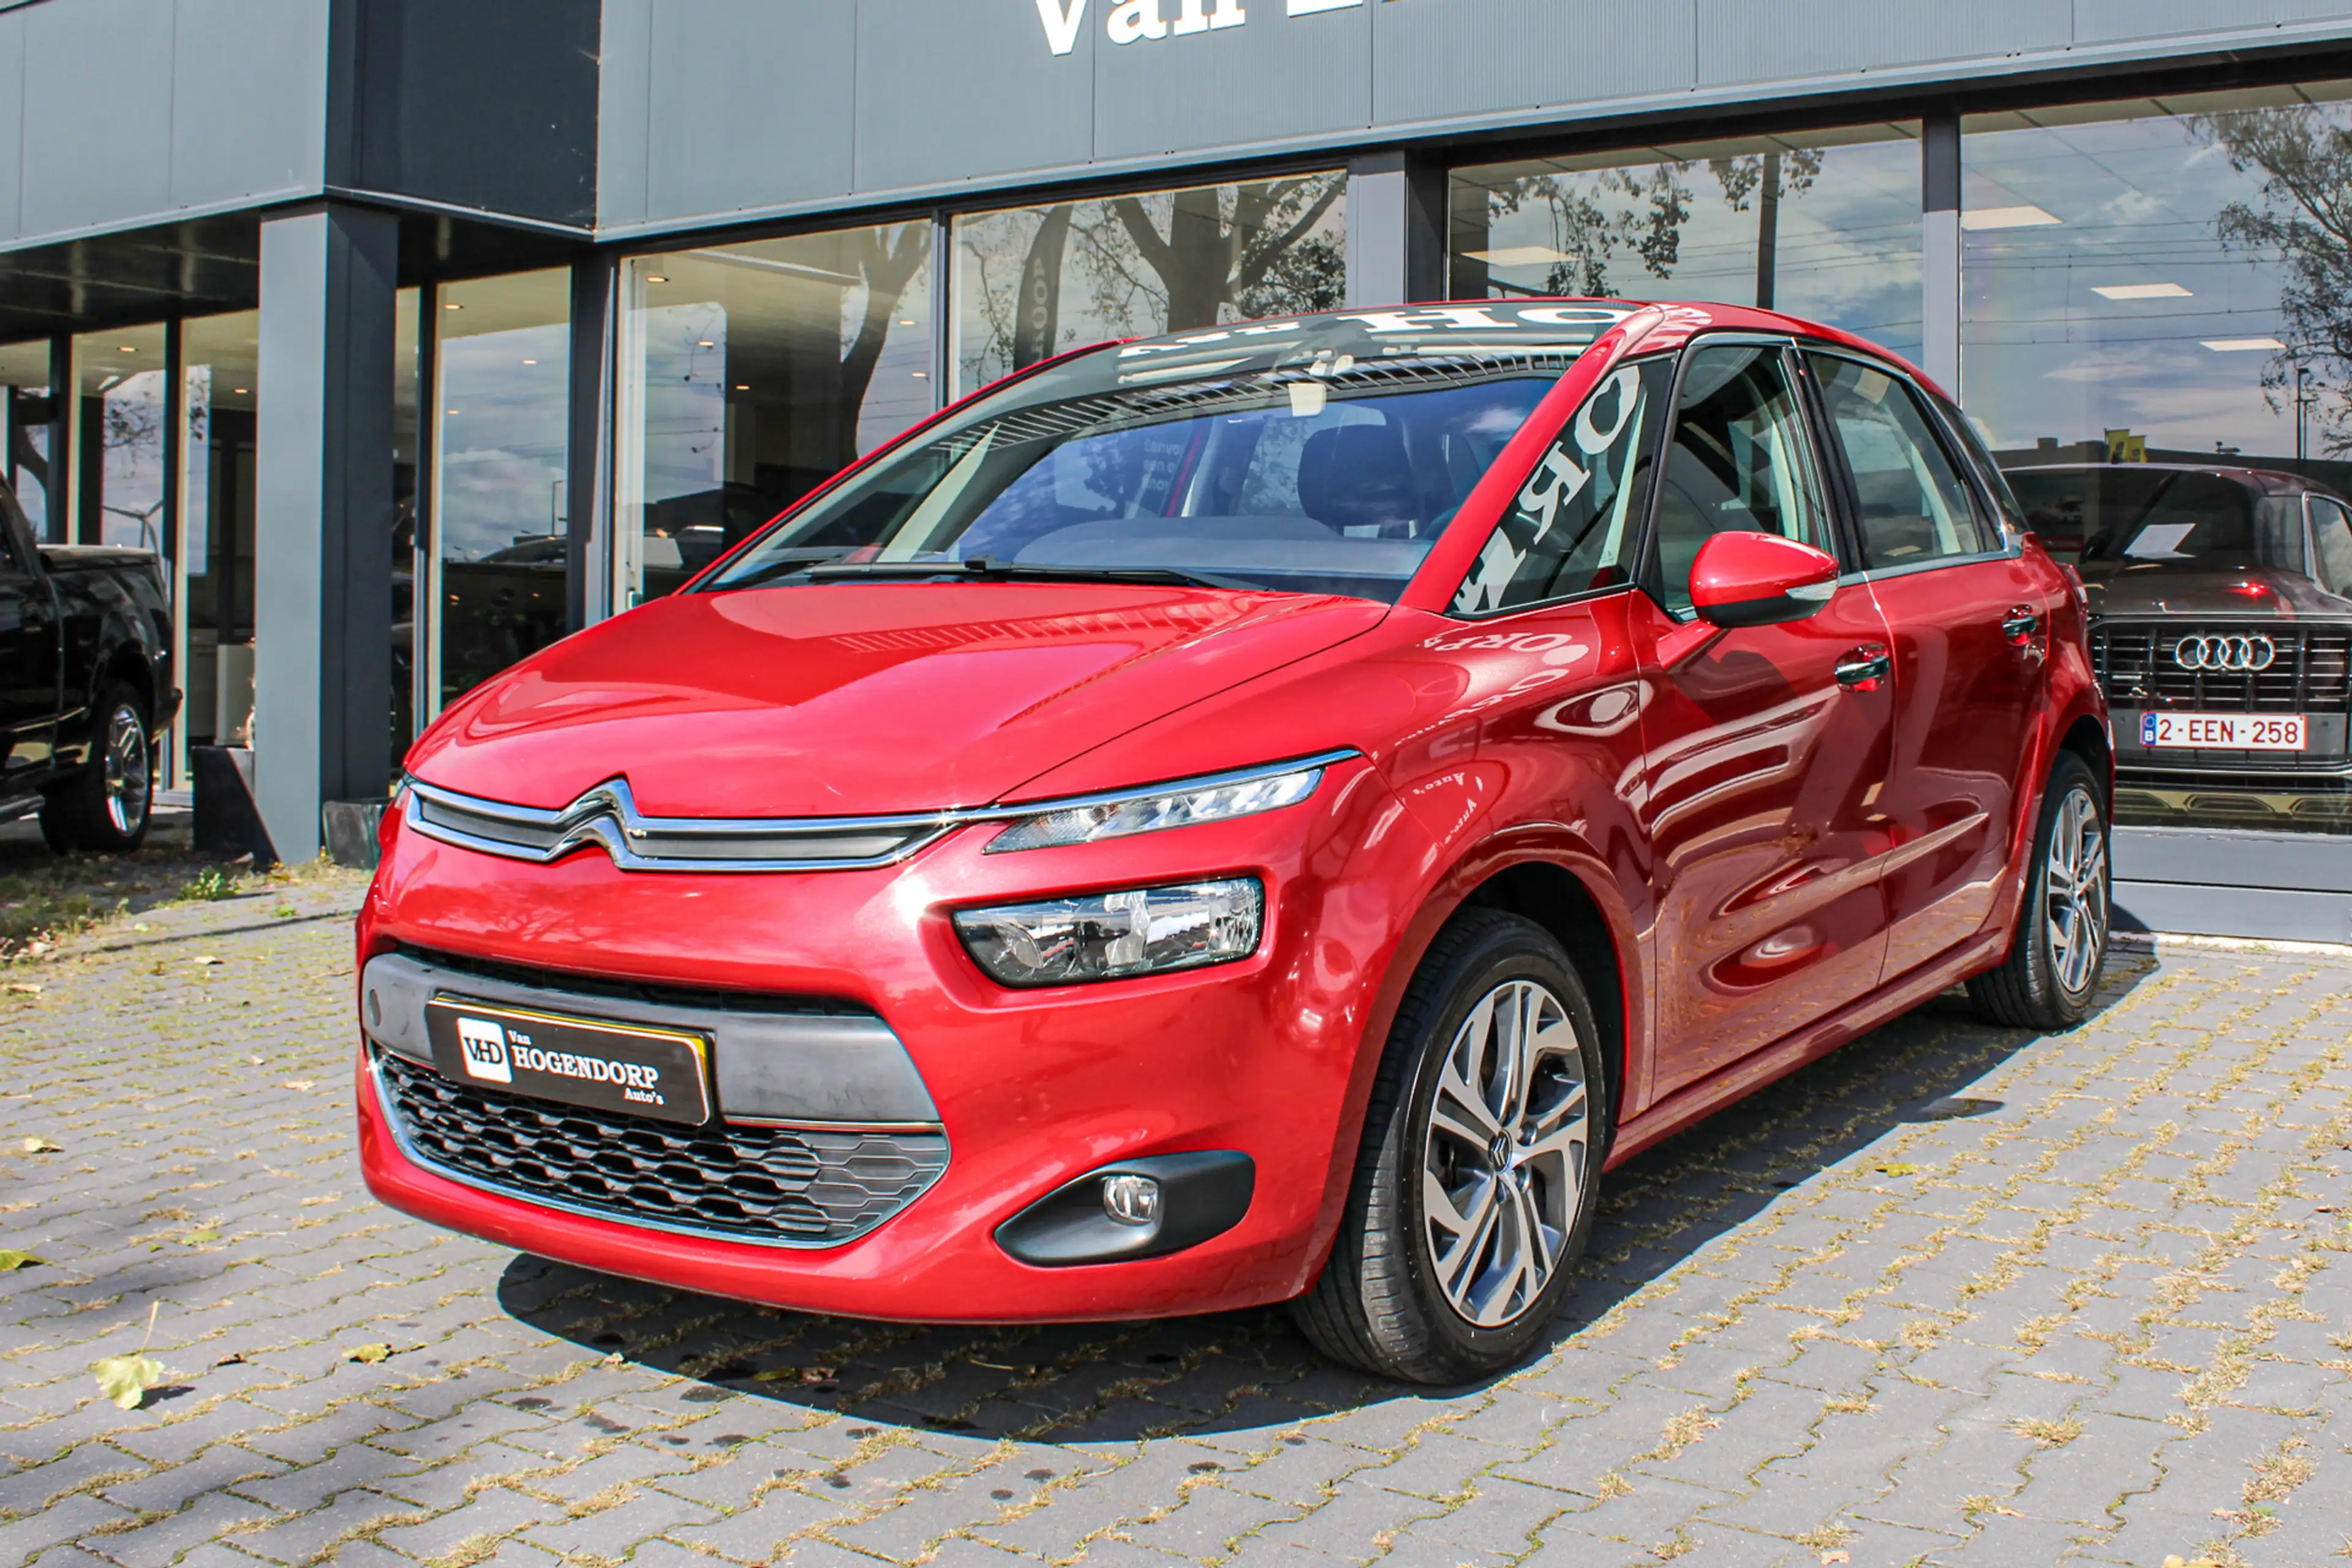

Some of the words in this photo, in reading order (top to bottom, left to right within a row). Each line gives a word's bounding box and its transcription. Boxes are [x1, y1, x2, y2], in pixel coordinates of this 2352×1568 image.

[507, 1029, 532, 1046] Van
[511, 1044, 659, 1090] HOGENDORP
[624, 1087, 665, 1106] Auto's
